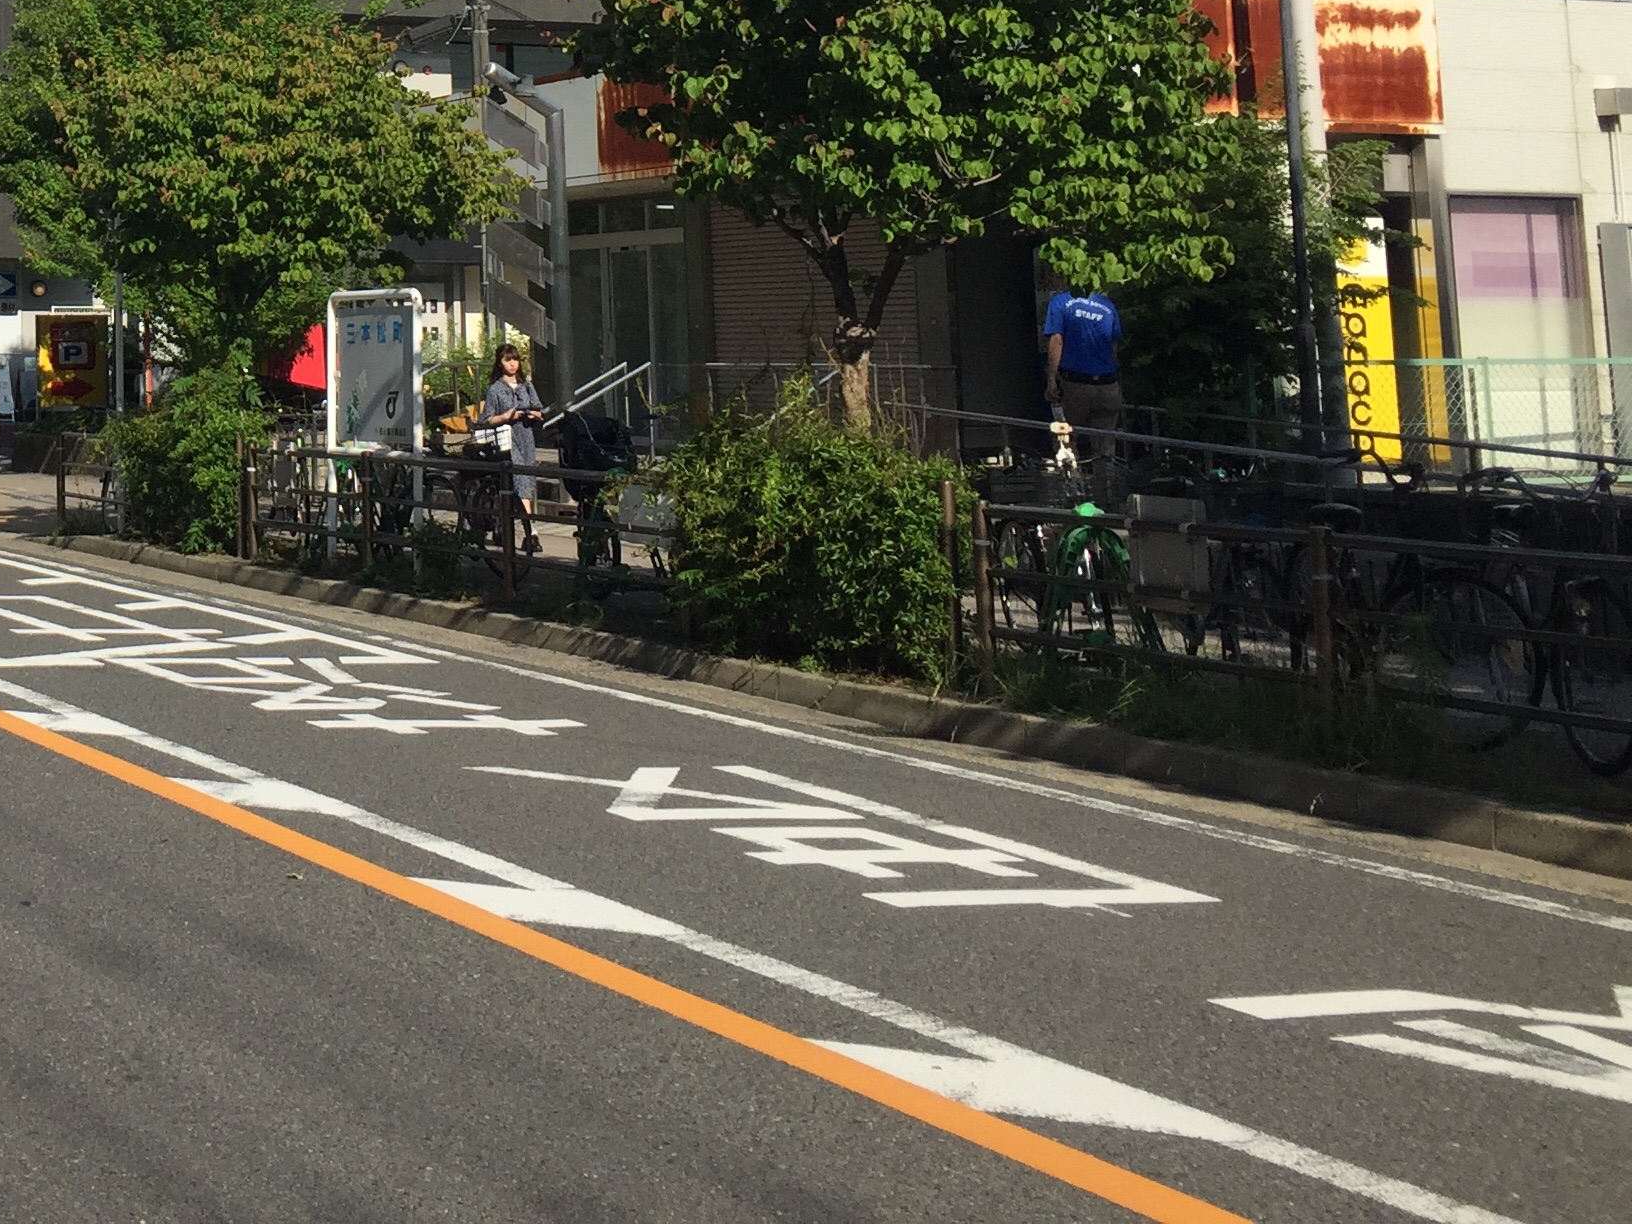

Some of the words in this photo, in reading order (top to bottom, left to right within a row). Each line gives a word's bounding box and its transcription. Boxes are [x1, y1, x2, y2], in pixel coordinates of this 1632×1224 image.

[1075, 309, 1104, 322] STAFF
[346, 321, 403, 346] 三本松町
[63, 345, 83, 362] P
